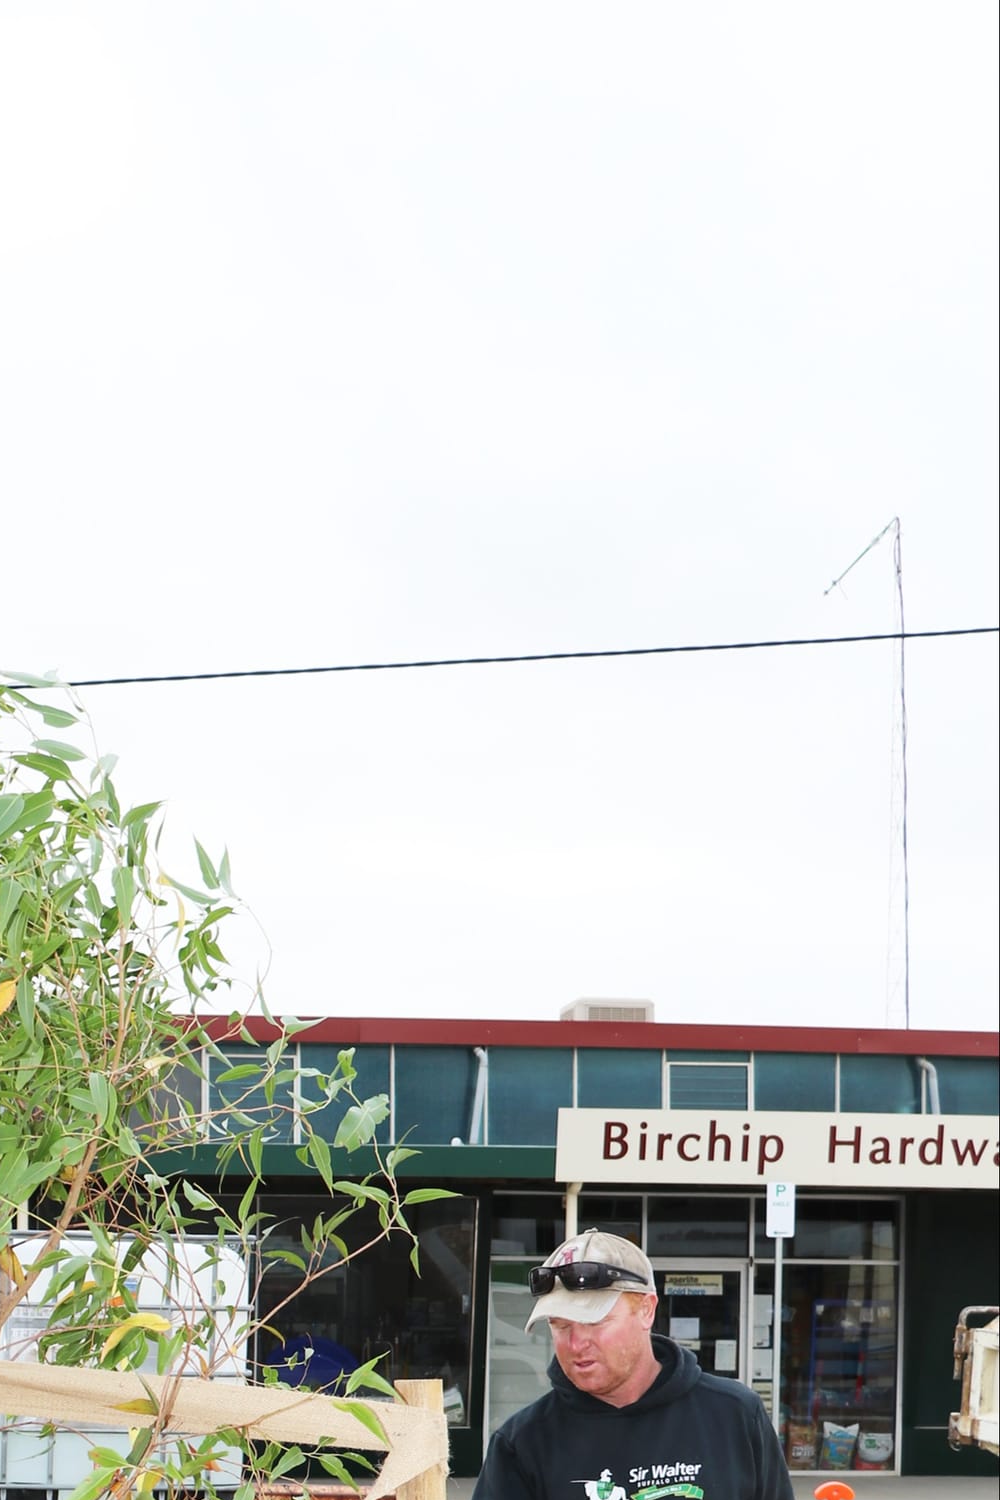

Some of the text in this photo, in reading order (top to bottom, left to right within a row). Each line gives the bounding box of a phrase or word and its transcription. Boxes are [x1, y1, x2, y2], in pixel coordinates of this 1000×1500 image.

[603, 1120, 999, 1175] Birchip Hardw
[775, 1184, 786, 1197] P
[629, 1462, 701, 1482] Sir Walter
[637, 1478, 670, 1487] BUFFALO
